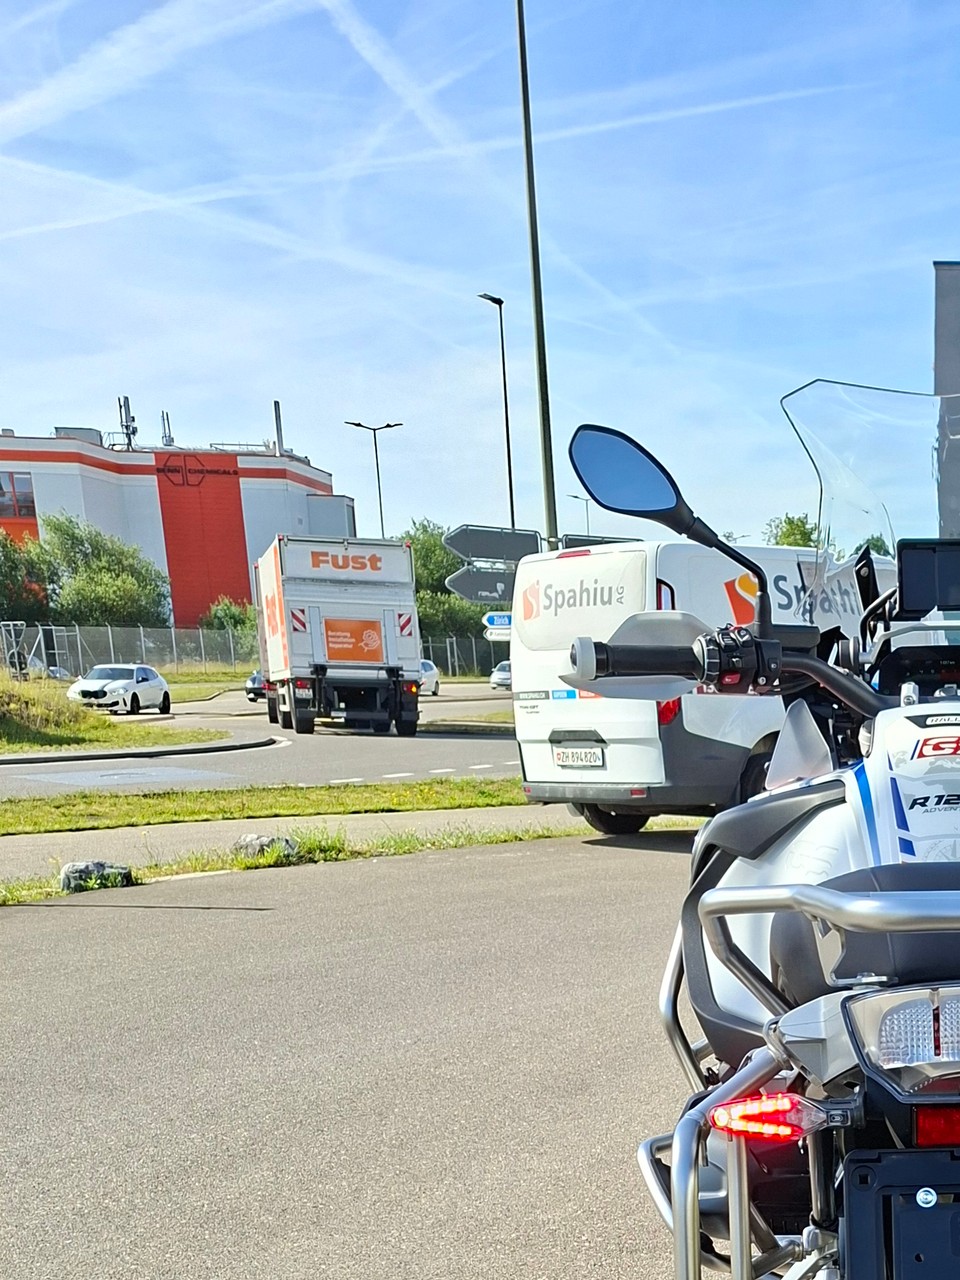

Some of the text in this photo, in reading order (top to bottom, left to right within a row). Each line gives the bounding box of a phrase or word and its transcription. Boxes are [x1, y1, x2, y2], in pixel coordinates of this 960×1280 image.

[311, 551, 382, 571] Fust
[543, 579, 625, 617] Spahiu AG
[561, 751, 597, 764] ZH 894820
